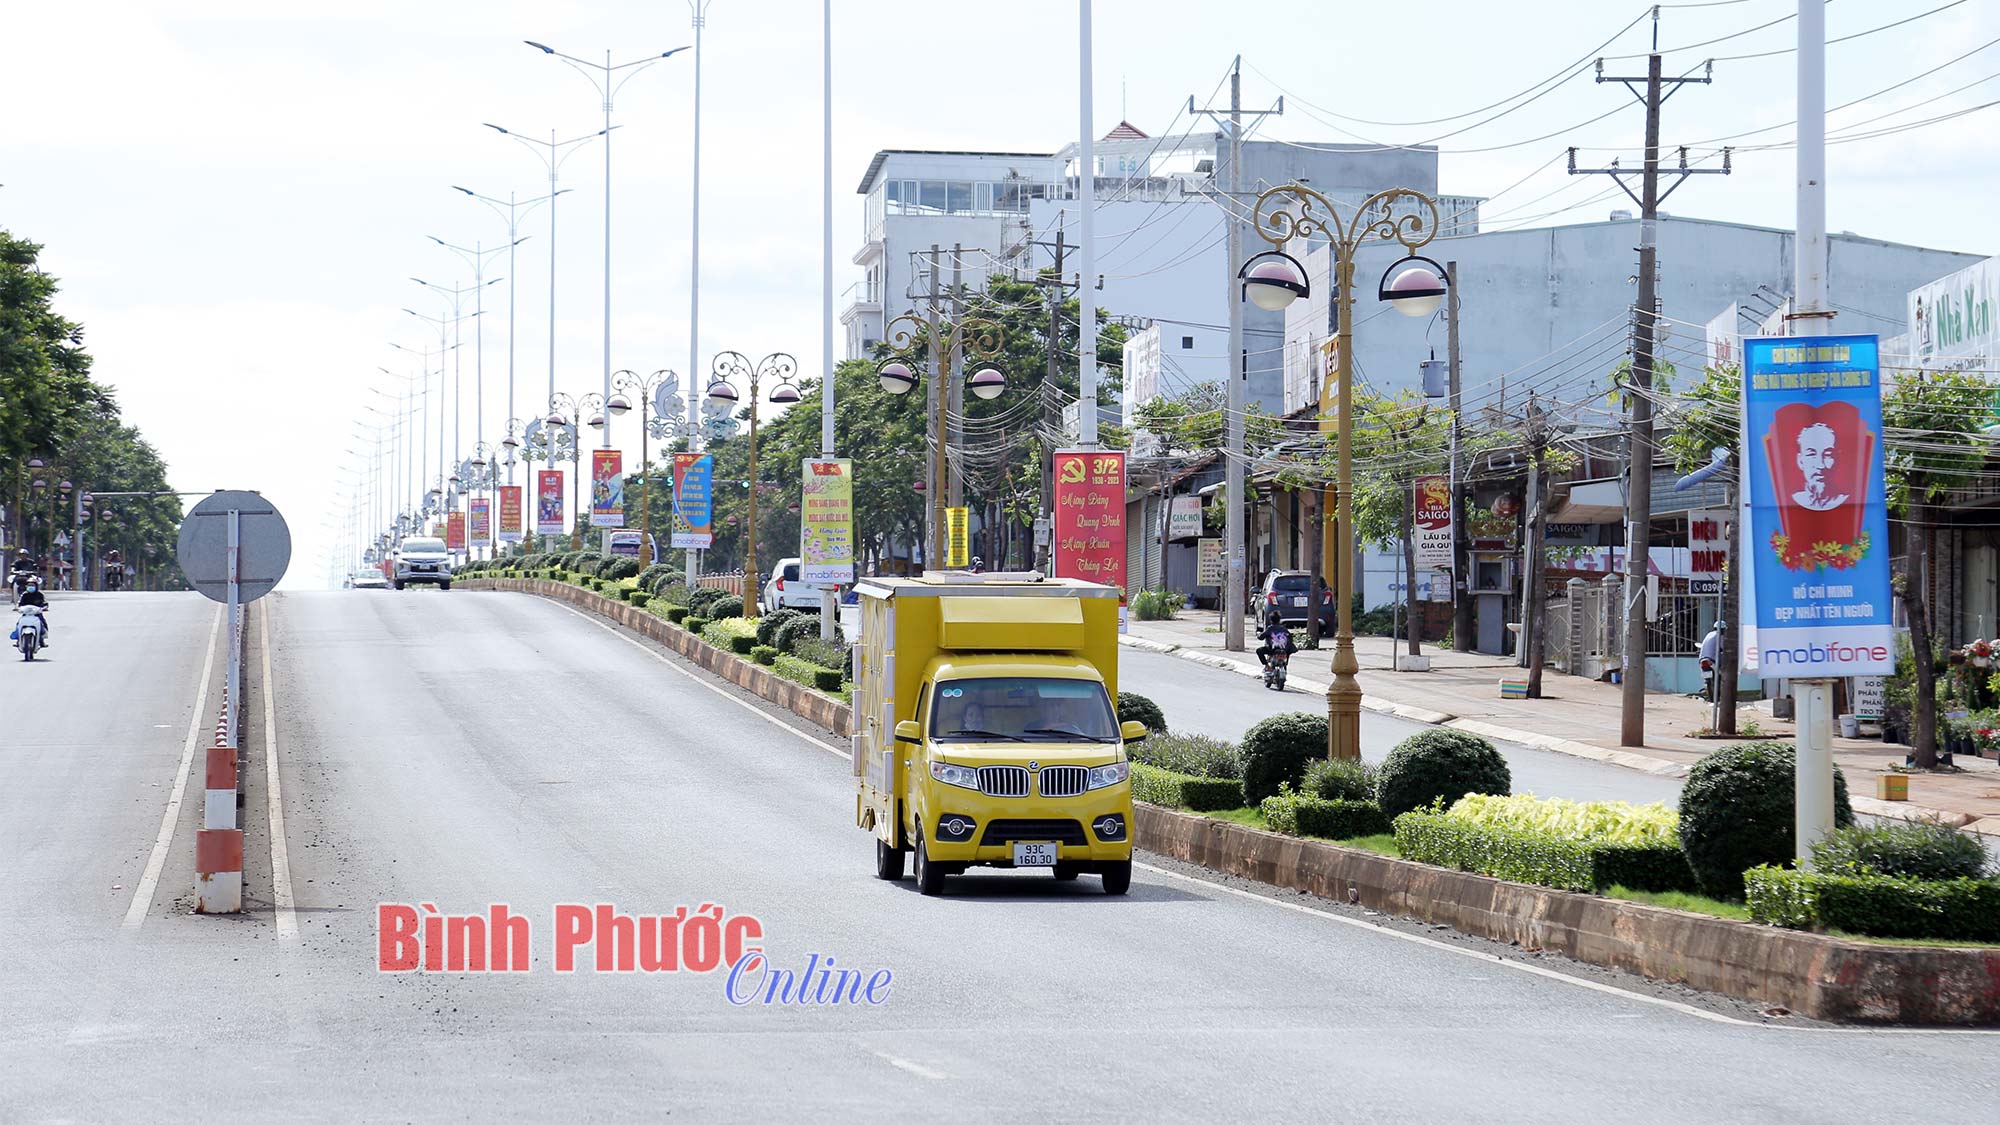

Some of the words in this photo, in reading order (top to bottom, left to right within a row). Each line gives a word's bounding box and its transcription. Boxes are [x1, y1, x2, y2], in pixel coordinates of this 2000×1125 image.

[1936, 294, 1962, 351] Nhà
[1093, 459, 1119, 475] 3/2
[1418, 510, 1451, 520] SAIGO
[806, 569, 852, 579] mobifone
[1792, 583, 1806, 599] HỒ
[1808, 583, 1825, 599] CHÍ
[1826, 585, 1853, 598] MINH
[1775, 607, 1794, 622] ĐẸP
[1796, 602, 1821, 619] NHẤT
[1823, 603, 1841, 618] TÊN
[1843, 602, 1873, 617] NGƯỜI
[1765, 641, 1888, 664] mobifone
[1026, 844, 1044, 854] 93C
[1020, 855, 1052, 864] 160.30
